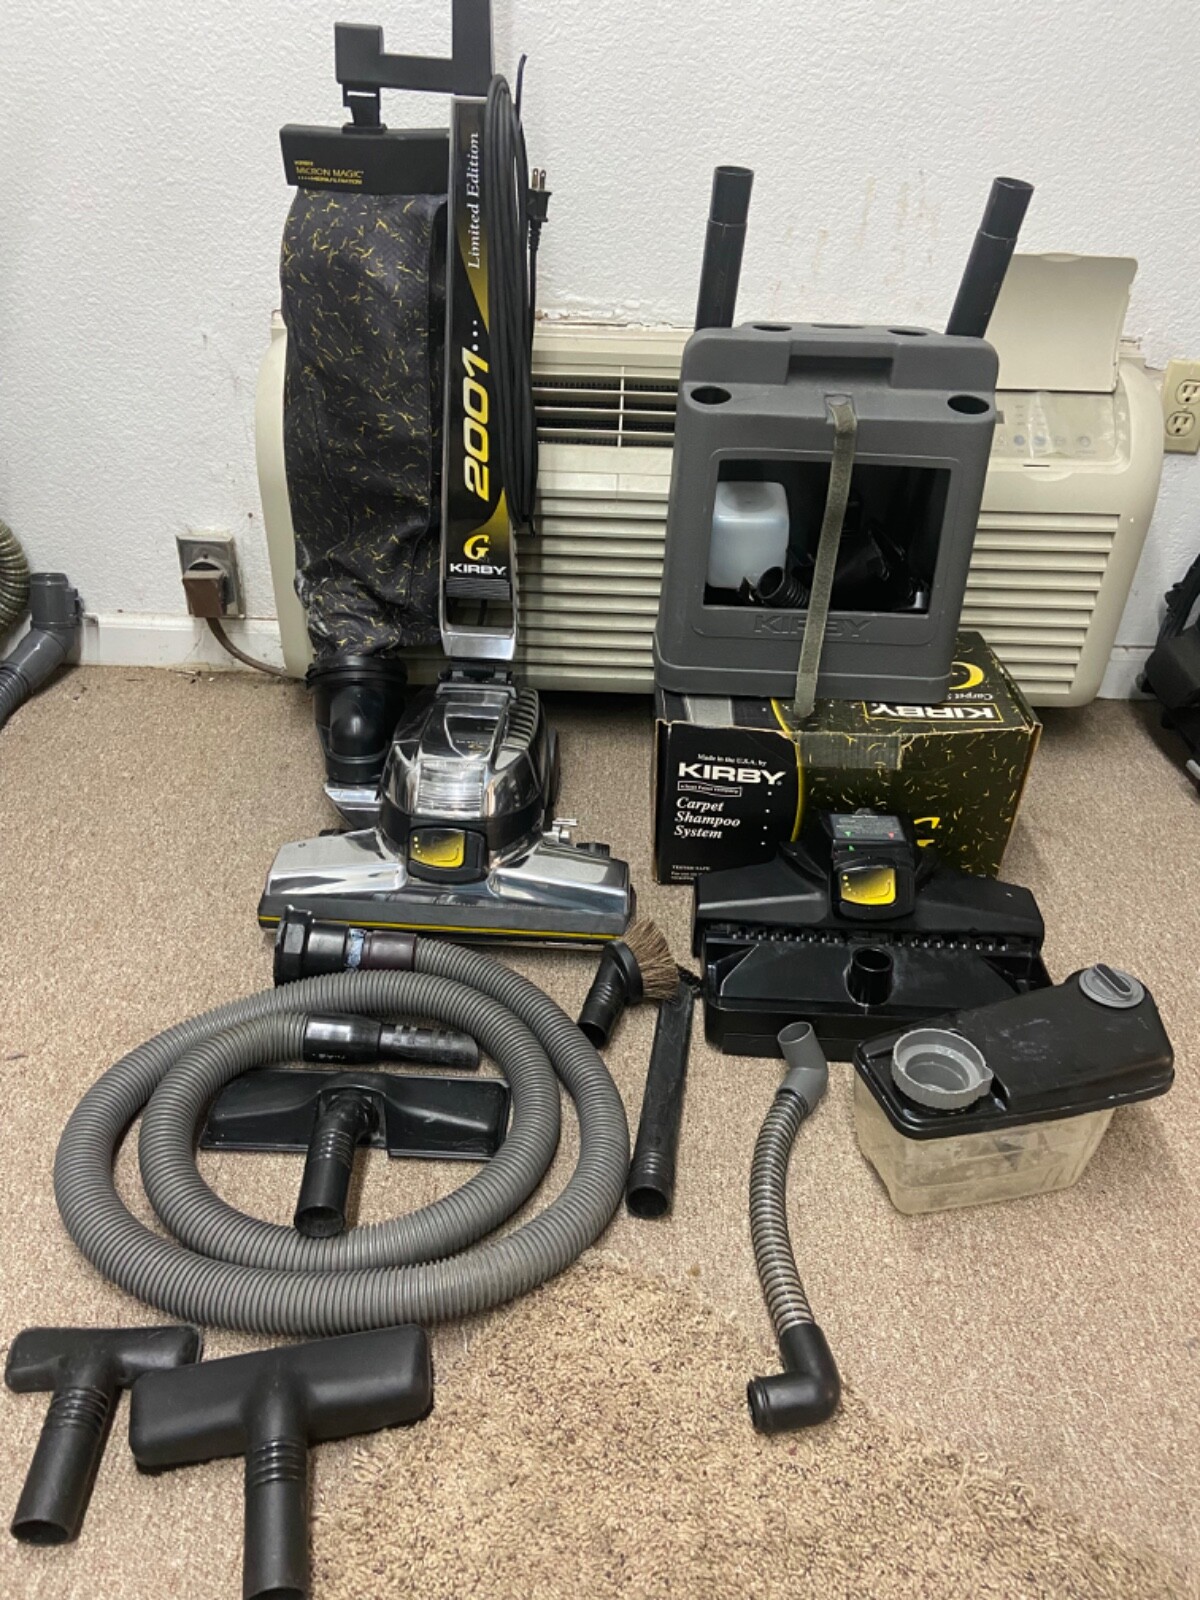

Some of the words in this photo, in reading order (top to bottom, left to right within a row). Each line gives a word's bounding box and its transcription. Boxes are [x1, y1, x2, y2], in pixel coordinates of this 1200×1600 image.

[296, 166, 331, 177] MICRON
[332, 169, 362, 179] MAGIC
[466, 132, 480, 198] Edition
[467, 201, 481, 269] Limited
[450, 563, 507, 576] KIRBY
[871, 703, 995, 720] KIRBY
[697, 753, 716, 762] Made
[678, 762, 786, 785] KIRBY
[676, 797, 725, 813] Carpet
[674, 810, 741, 828] Shampoo
[674, 824, 723, 839] System
